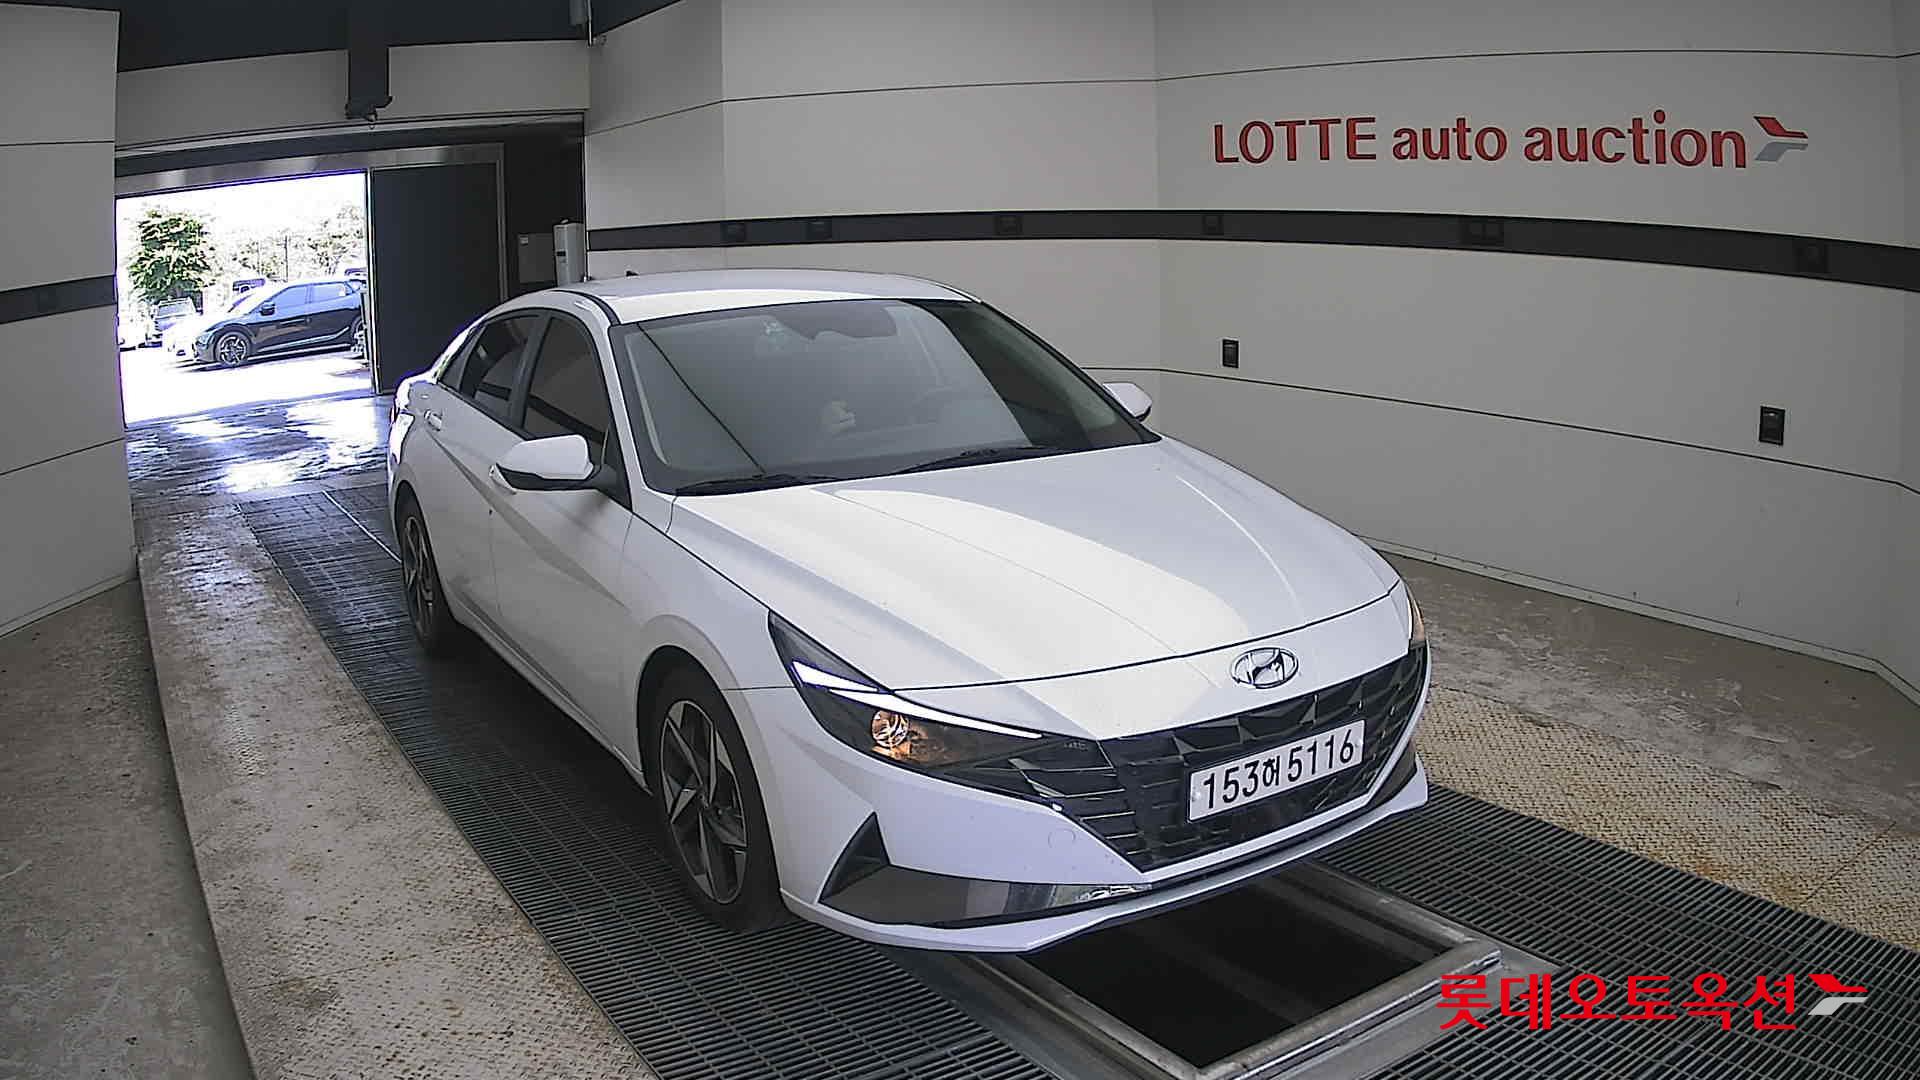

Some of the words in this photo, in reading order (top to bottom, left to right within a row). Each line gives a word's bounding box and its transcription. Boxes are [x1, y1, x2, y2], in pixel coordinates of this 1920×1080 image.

[1214, 117, 1376, 163] LOTTE
[1392, 117, 1508, 162] auto
[1523, 110, 1746, 168] auction
